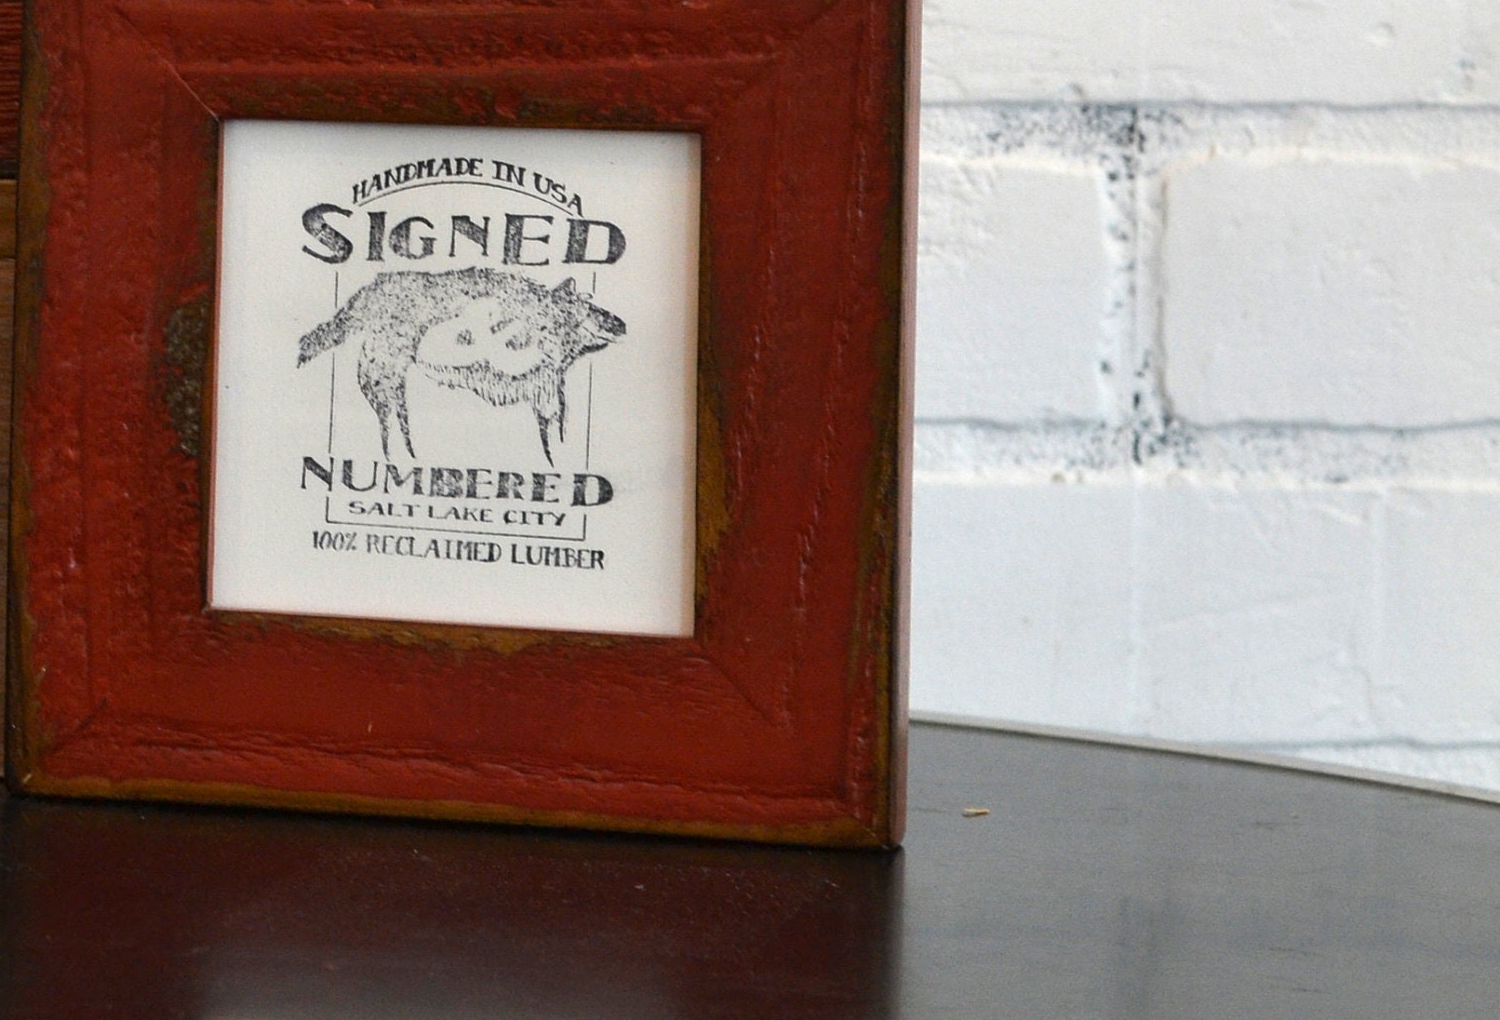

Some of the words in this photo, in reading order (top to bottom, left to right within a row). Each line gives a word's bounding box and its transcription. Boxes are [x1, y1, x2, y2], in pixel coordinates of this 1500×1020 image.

[350, 157, 484, 205] HANDMADE
[491, 160, 527, 188] IN
[533, 172, 585, 218] USA
[301, 203, 627, 266] SIGNED
[301, 456, 615, 508] NUMBERED
[348, 500, 422, 519] SALT
[428, 504, 494, 524] LAKE
[503, 510, 567, 527] CITY
[311, 531, 358, 552] 100%
[366, 533, 502, 564] RECLAIMED
[511, 543, 606, 570] LUMBER
